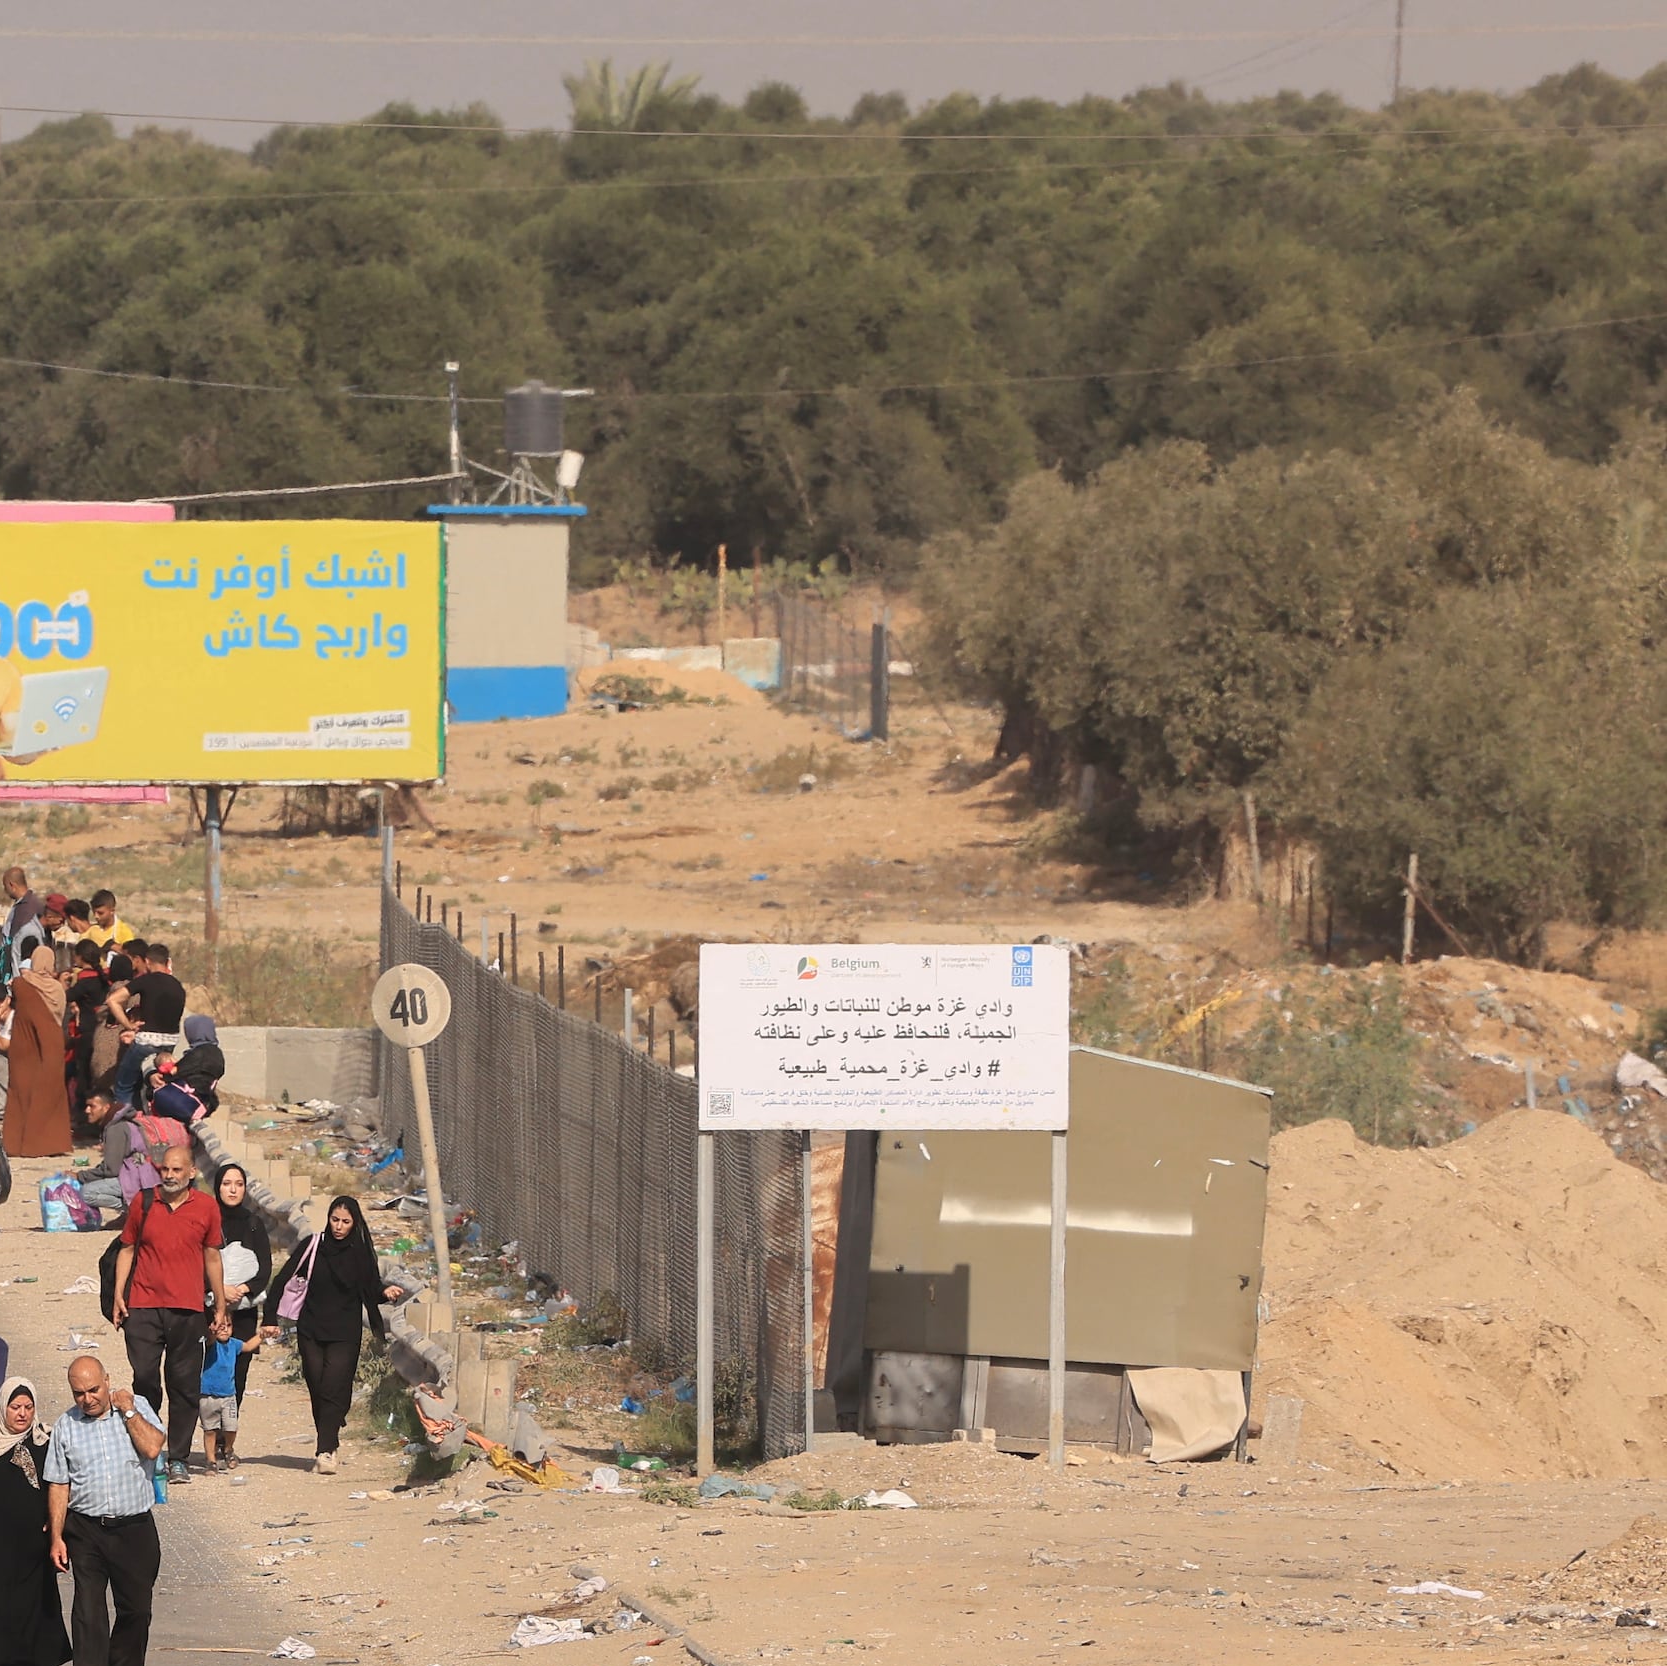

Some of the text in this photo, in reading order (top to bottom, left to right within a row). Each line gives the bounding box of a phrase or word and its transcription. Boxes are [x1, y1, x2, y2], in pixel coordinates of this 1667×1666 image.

[143, 545, 407, 600] اشبك أوفر نت
[203, 610, 408, 660] واربح كاش
[831, 958, 880, 971] Belgium
[390, 988, 429, 1027] 40
[759, 996, 1013, 1018] وادي غزة موطن للنباتات والطيور
[754, 1023, 801, 1040] نظافته
[854, 1025, 886, 1043] عليه
[893, 1024, 950, 1039] فلنحافظ
